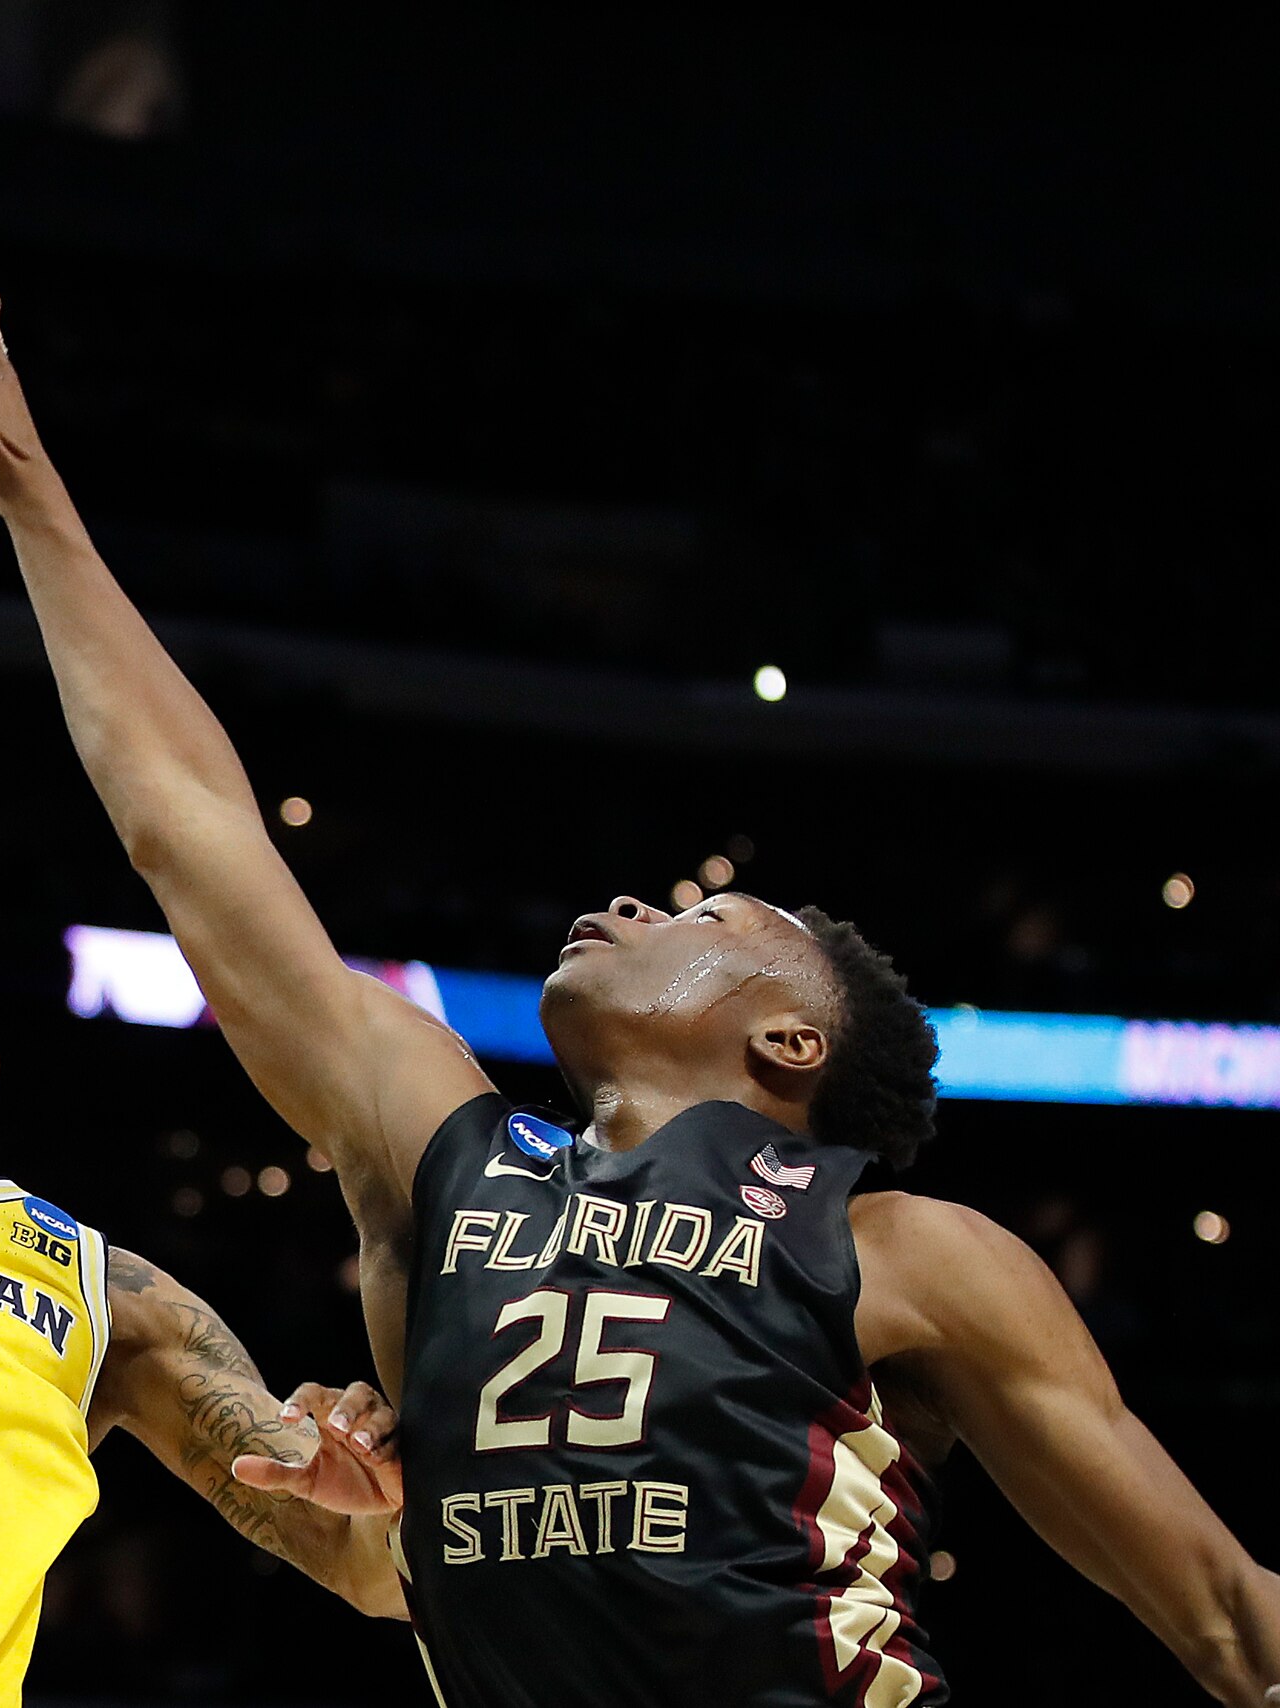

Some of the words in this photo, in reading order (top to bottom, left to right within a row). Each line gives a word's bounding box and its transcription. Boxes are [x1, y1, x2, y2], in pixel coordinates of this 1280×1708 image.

[31, 1207, 77, 1237] NCAA
[474, 1287, 672, 1453] 25
[440, 1480, 689, 1565] STATE
